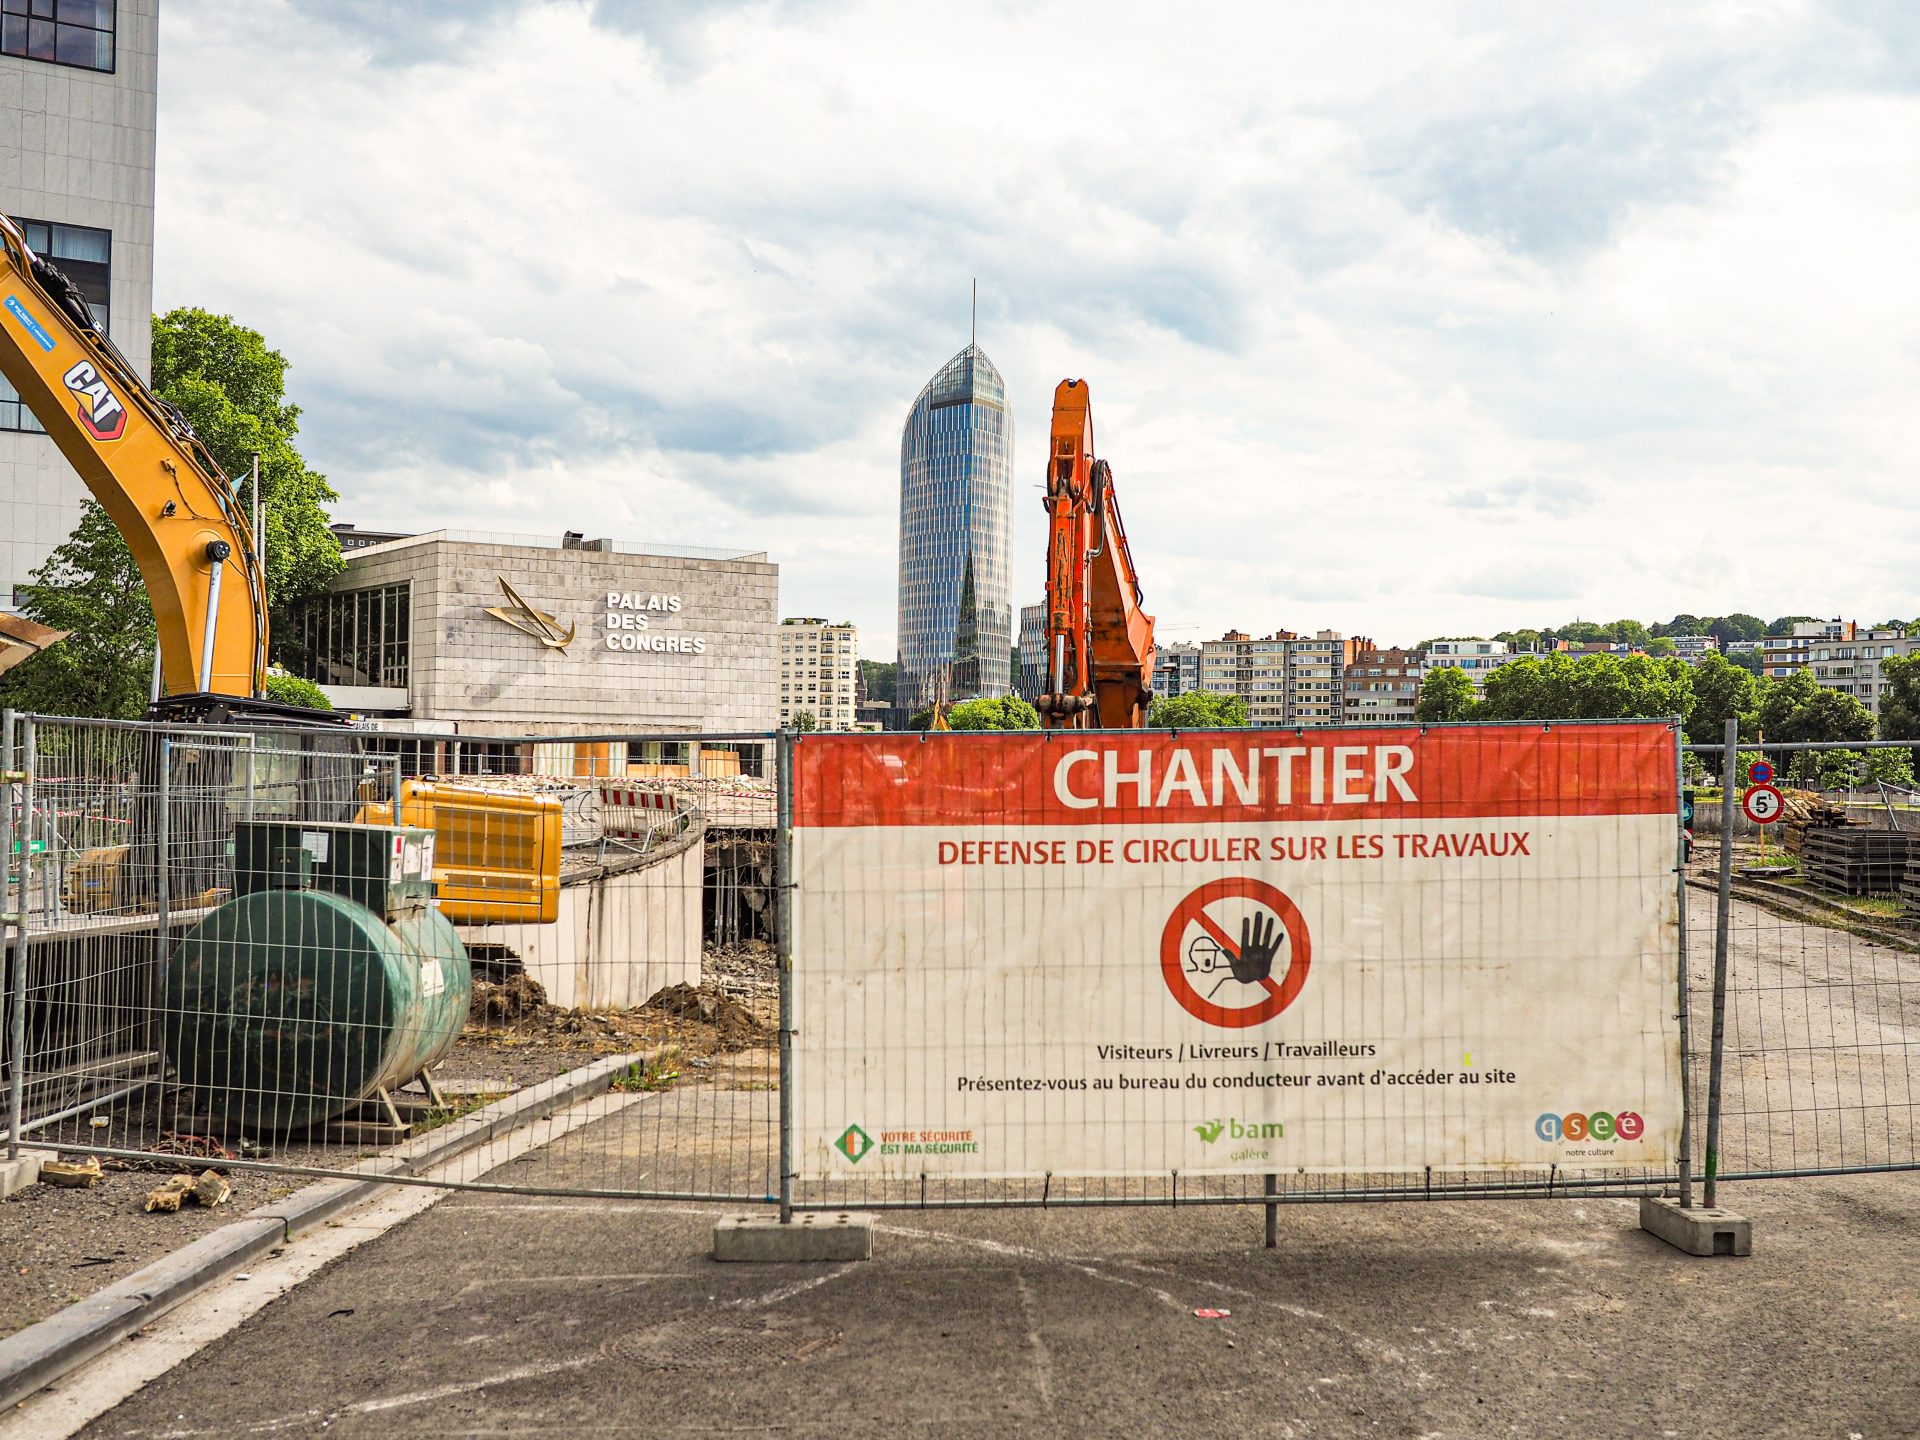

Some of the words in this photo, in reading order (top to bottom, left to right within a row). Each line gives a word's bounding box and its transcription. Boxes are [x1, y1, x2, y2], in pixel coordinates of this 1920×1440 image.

[64, 361, 123, 424] CAT
[607, 592, 682, 613] PALAIS
[606, 612, 649, 631] DES
[606, 633, 706, 654] CONGRES
[1053, 744, 1419, 809] CHANTIER
[938, 841, 1066, 865] DEFENSE
[1075, 839, 1114, 864] DE
[1123, 837, 1261, 863] CIRCULER
[1270, 836, 1328, 861] SUR
[1336, 834, 1384, 860] LES
[1392, 831, 1532, 859] TRAVAUX
[1097, 1044, 1173, 1060] Visiteurs
[1189, 1042, 1259, 1060] Livreurs
[1274, 1040, 1377, 1058] Travailleurs
[957, 1075, 1088, 1092] Présentez-vous
[1093, 1078, 1114, 1090] au
[1118, 1073, 1181, 1090] bureau
[1185, 1073, 1208, 1089] du
[1212, 1070, 1312, 1089] conducteur
[1316, 1073, 1366, 1087] avant
[1458, 1071, 1480, 1085] au
[1484, 1068, 1517, 1084] site
[881, 1131, 917, 1143] VOTRE
[919, 1129, 973, 1143] SÉCURITÉ
[1230, 1118, 1284, 1139] bam
[904, 1143, 923, 1155] MA
[925, 1142, 979, 1155] SÉCURITÉ
[1230, 1147, 1269, 1163] galère
[1565, 1149, 1586, 1157] notre
[1587, 1147, 1615, 1157] culture
